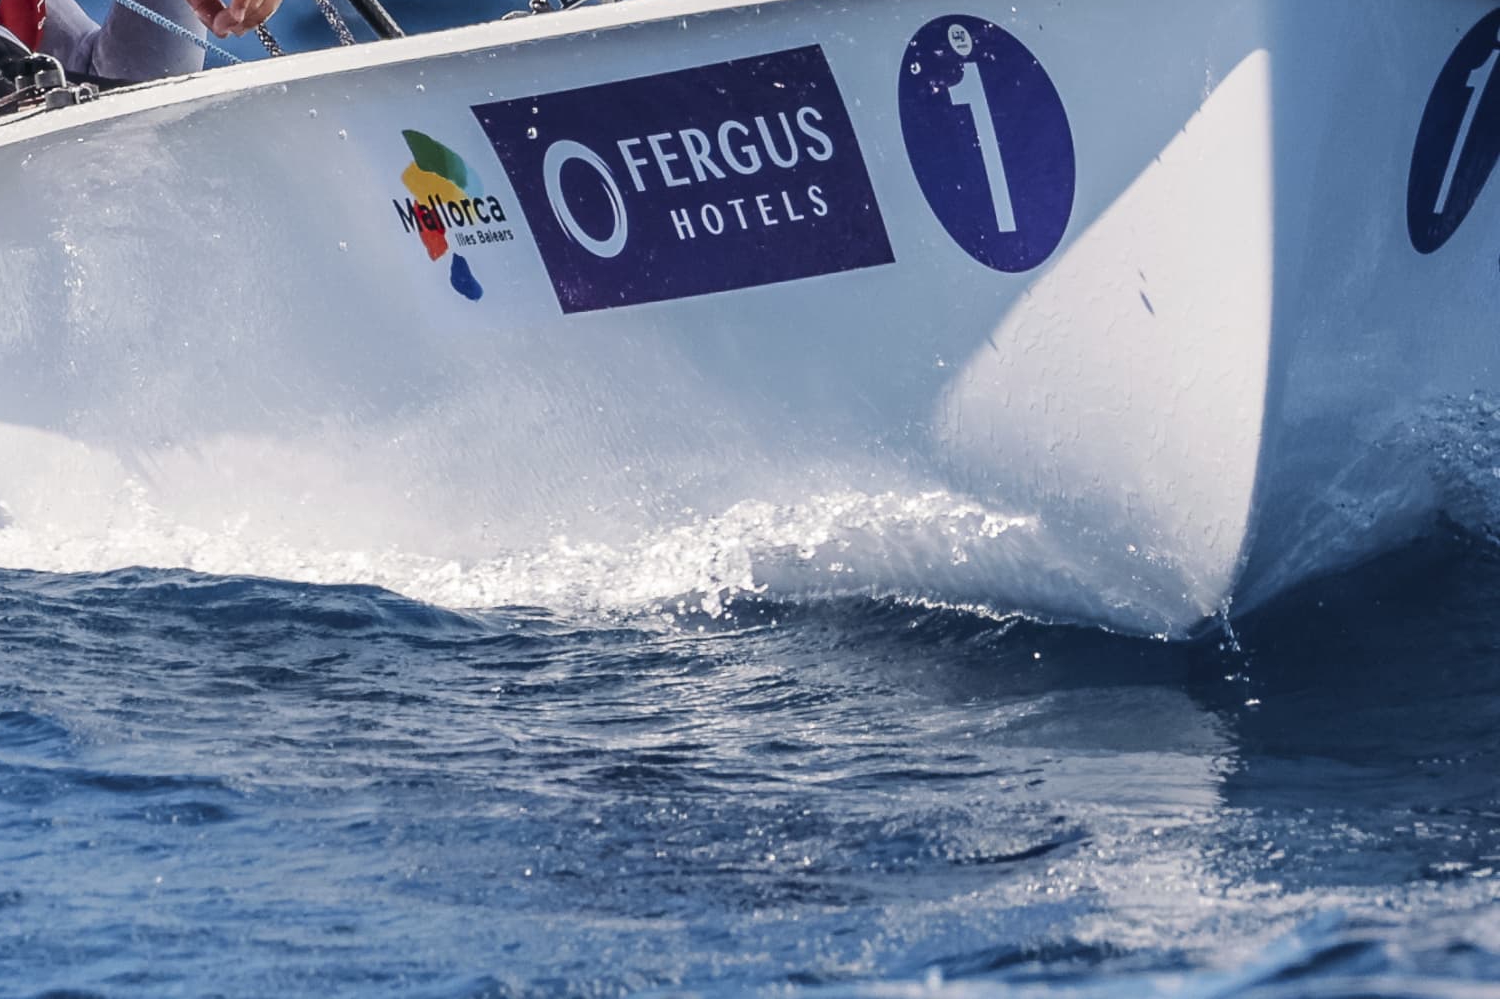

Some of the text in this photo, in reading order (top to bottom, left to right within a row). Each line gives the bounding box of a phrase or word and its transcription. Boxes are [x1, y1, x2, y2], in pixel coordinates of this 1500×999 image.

[616, 106, 834, 192] FERGUS
[947, 61, 1018, 233] 1
[1432, 49, 1500, 214] 1
[392, 193, 506, 233] Mallorca
[455, 228, 514, 247] Illes Balears
[670, 185, 828, 240] HOTELS
